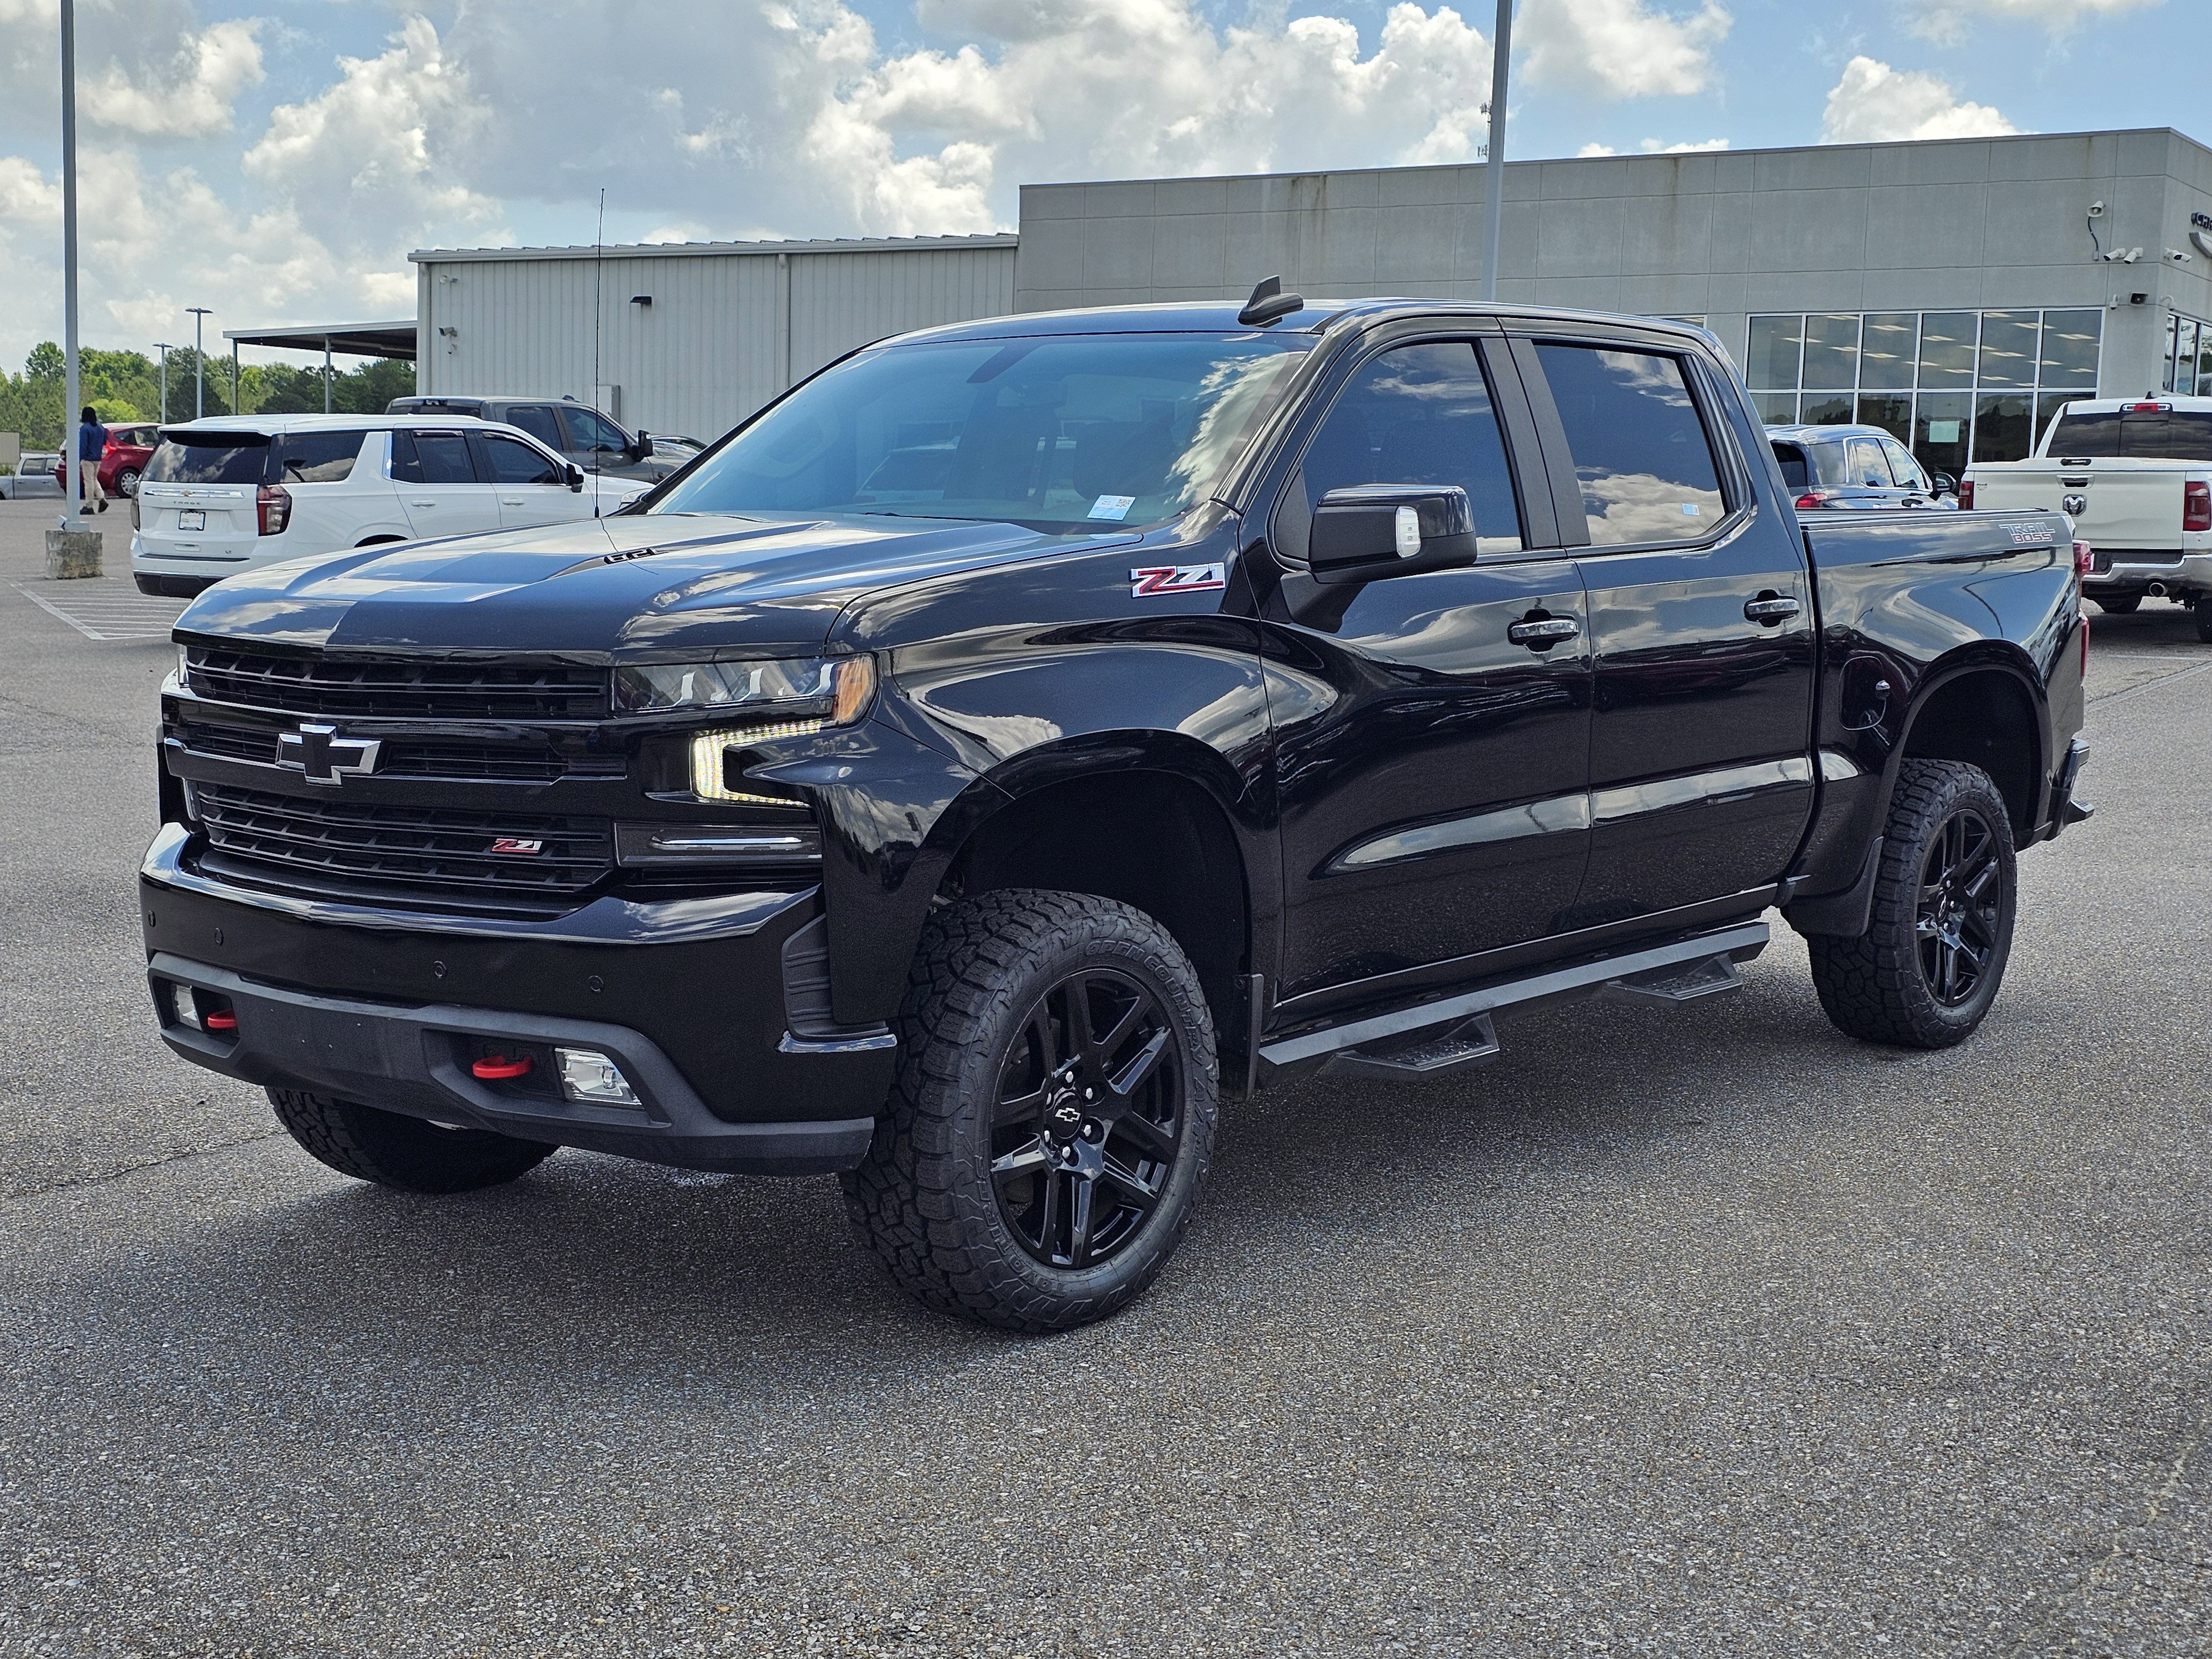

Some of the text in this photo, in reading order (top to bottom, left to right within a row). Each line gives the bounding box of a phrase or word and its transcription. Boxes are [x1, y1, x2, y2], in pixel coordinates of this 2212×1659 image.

[1999, 522, 2056, 534] TRAIL
[2011, 533, 2053, 544] BOSS
[1129, 562, 1226, 598] Z71
[492, 838, 542, 854] Z71
[1086, 940, 1145, 961] OPEN
[1144, 956, 1203, 1065] COUNTRY
[974, 1155, 1067, 1297] TOYO TIRES
